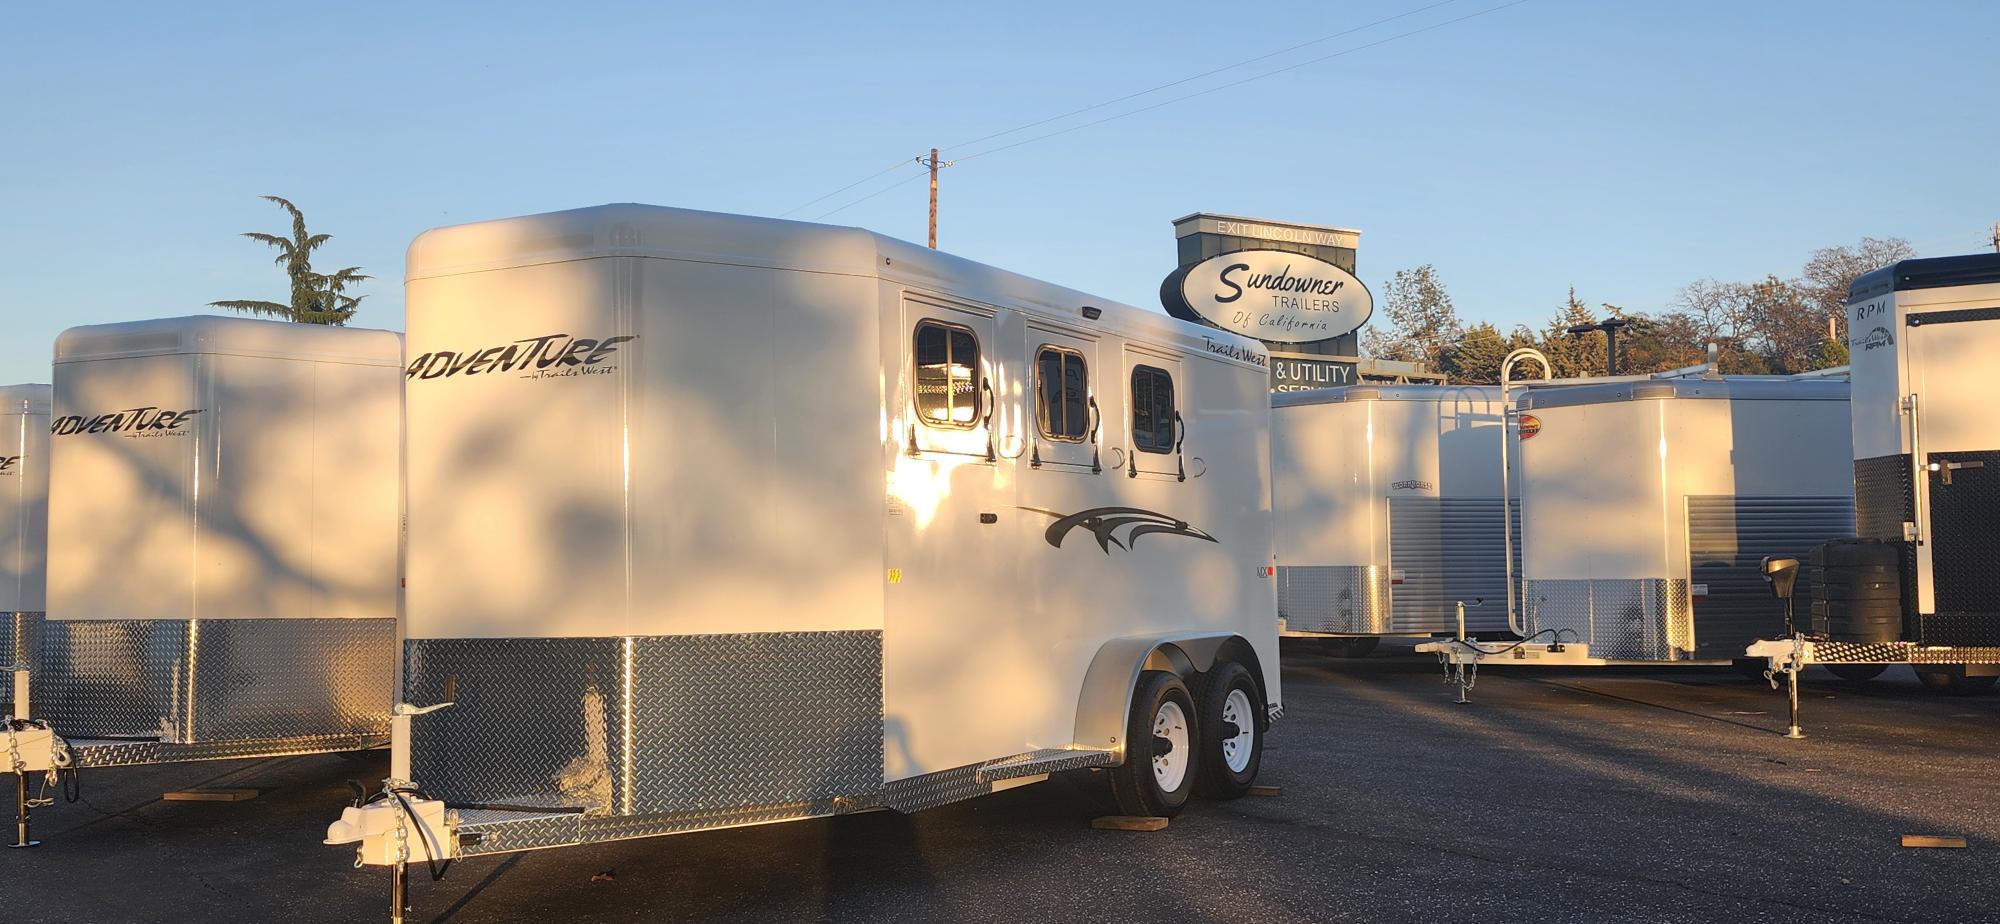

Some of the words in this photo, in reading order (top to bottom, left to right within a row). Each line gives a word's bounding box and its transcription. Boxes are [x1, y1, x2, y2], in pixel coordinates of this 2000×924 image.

[1217, 220, 1249, 235] EXIT
[1252, 225, 1311, 243] LINCOLN
[1315, 232, 1344, 246] WAY
[1214, 263, 1344, 304] Sundowner
[1272, 295, 1340, 313] TRAILERS
[1856, 300, 1886, 321] RPM
[1232, 311, 1252, 328] Of
[1258, 313, 1328, 332] California
[1202, 335, 1241, 361] Trails
[1241, 345, 1267, 367] West
[1865, 340, 1886, 351] RPM
[405, 333, 635, 381] ADVENTURE
[537, 368, 578, 379] Trails
[581, 366, 614, 376] West
[1276, 361, 1287, 380] &
[1290, 362, 1350, 383] UTILITY
[50, 406, 203, 436] ADVENTURE
[136, 430, 163, 438] Trails
